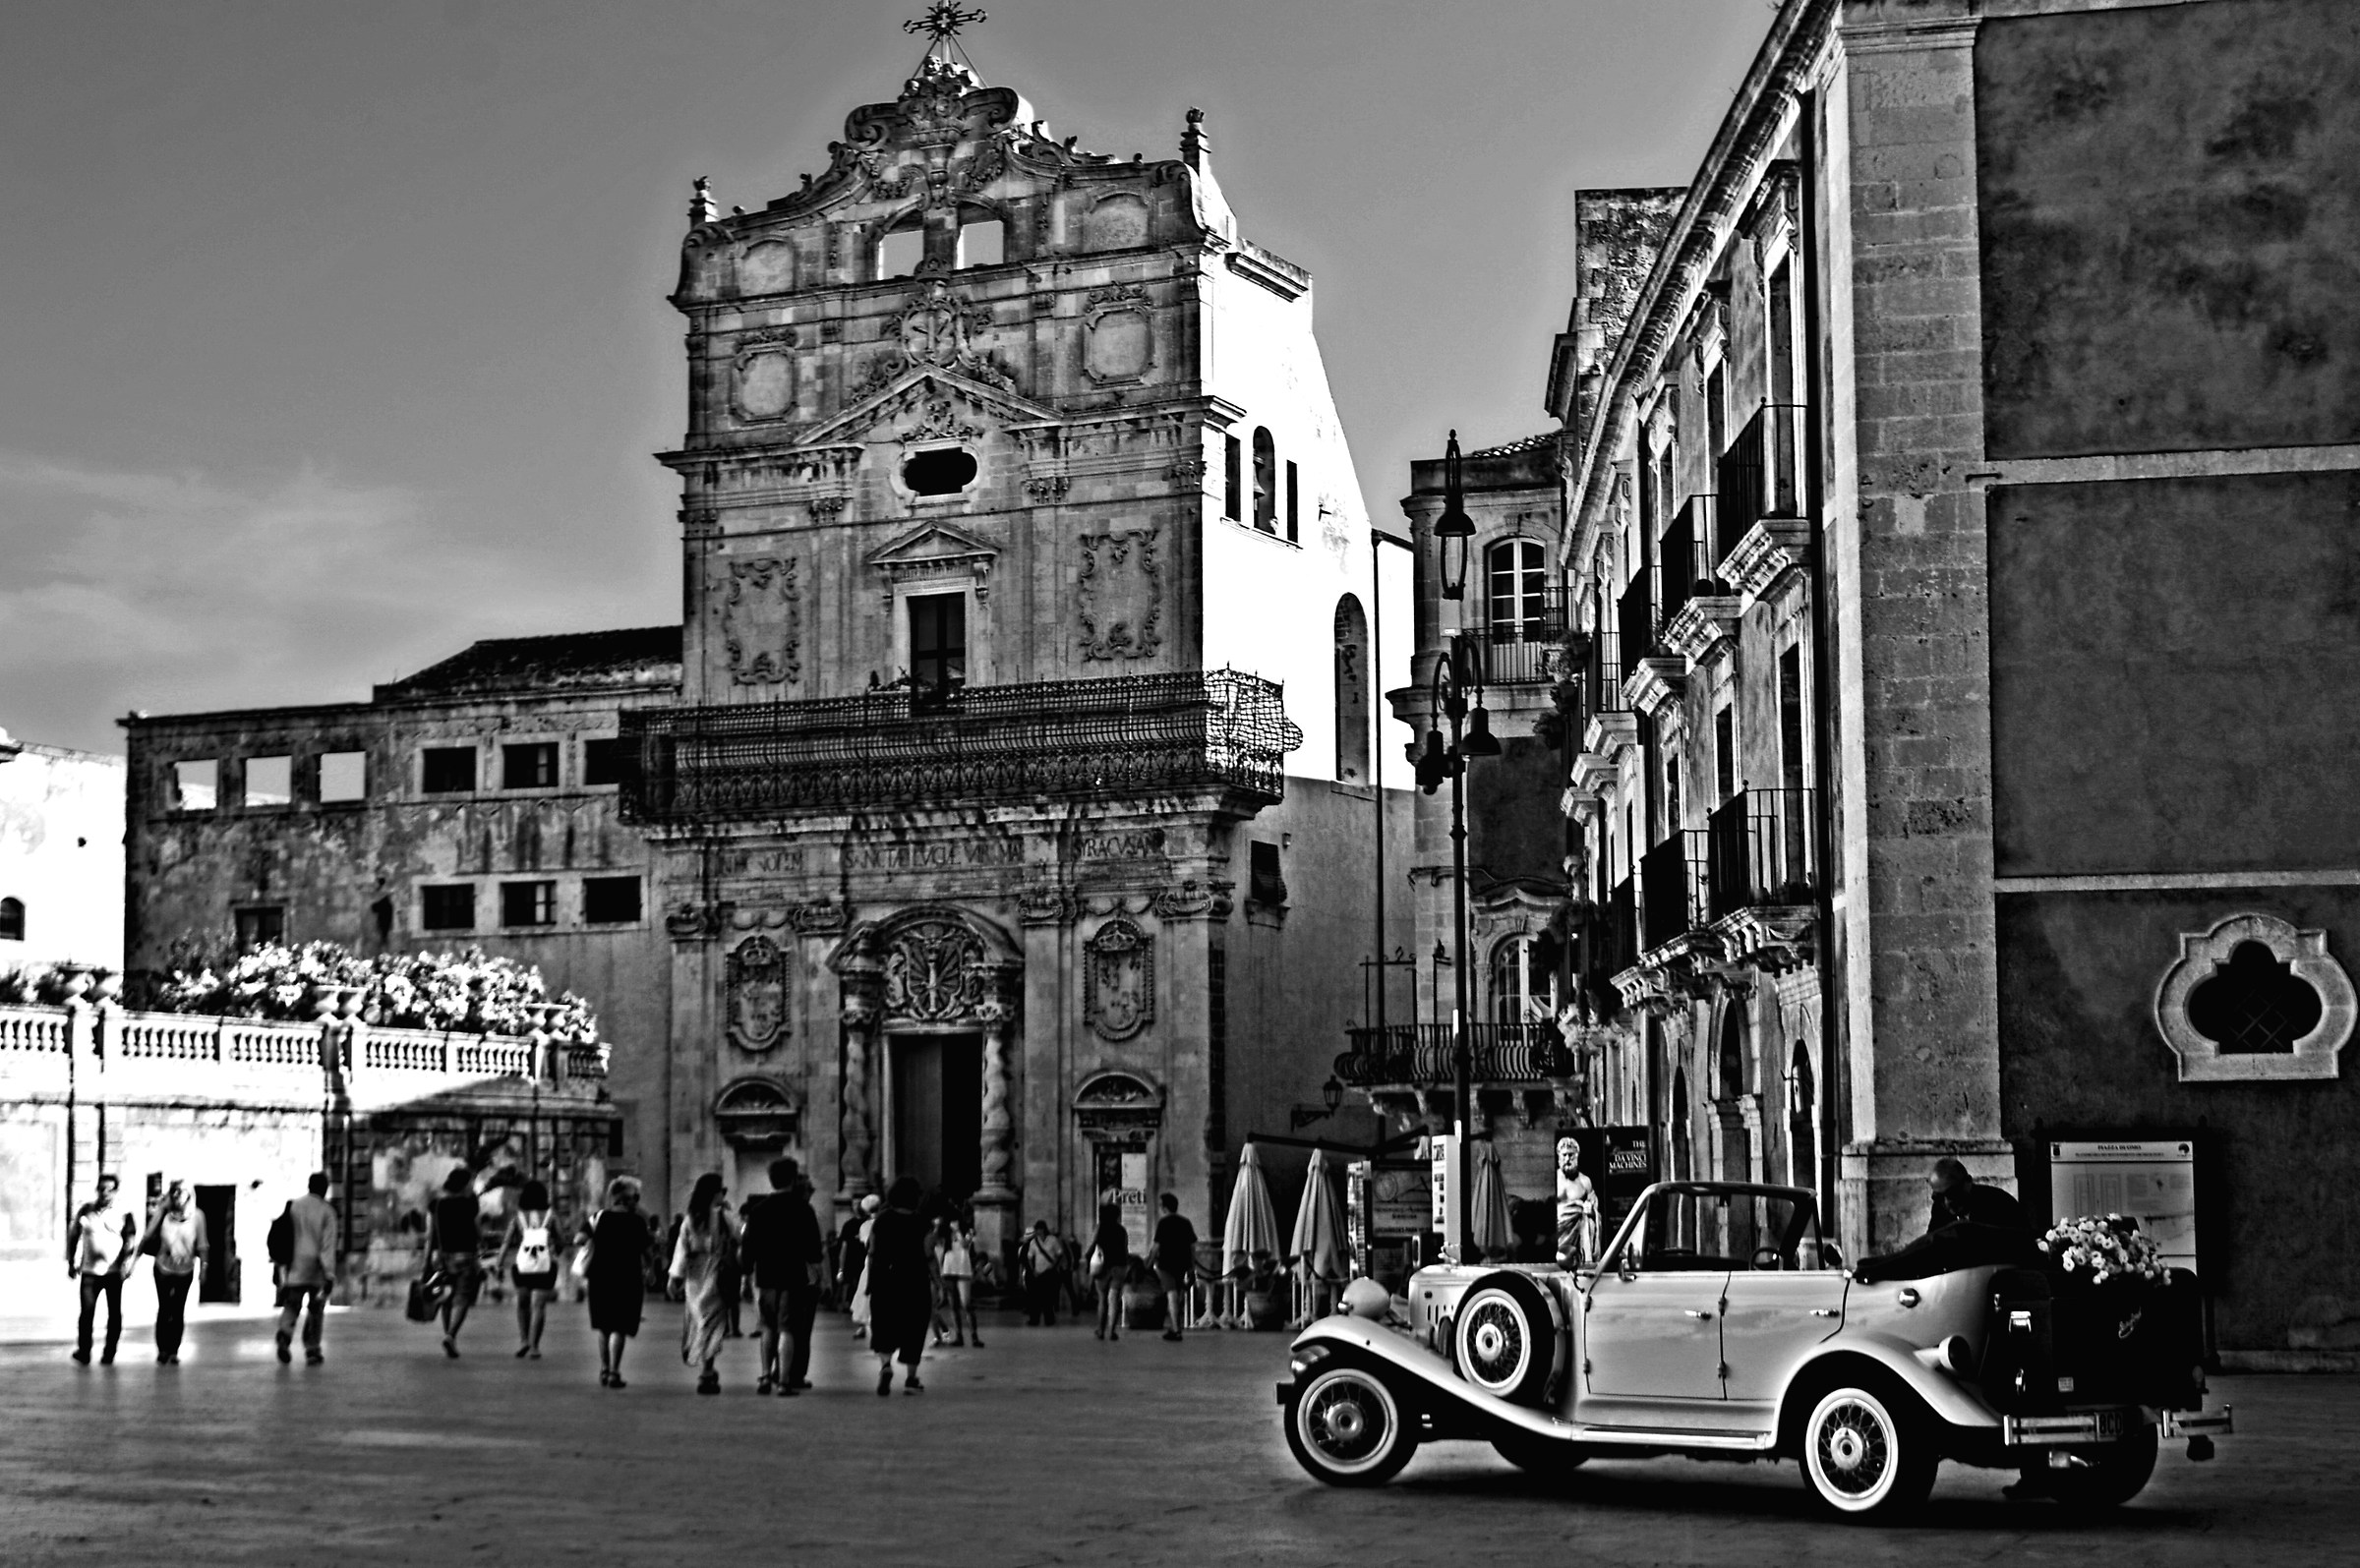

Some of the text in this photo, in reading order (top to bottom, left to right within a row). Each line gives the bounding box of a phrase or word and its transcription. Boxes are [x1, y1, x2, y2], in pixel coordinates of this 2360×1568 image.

[1632, 1139, 1647, 1148] THE
[1609, 1161, 1647, 1170] MACHINES
[1110, 1188, 1148, 1204] Preti
